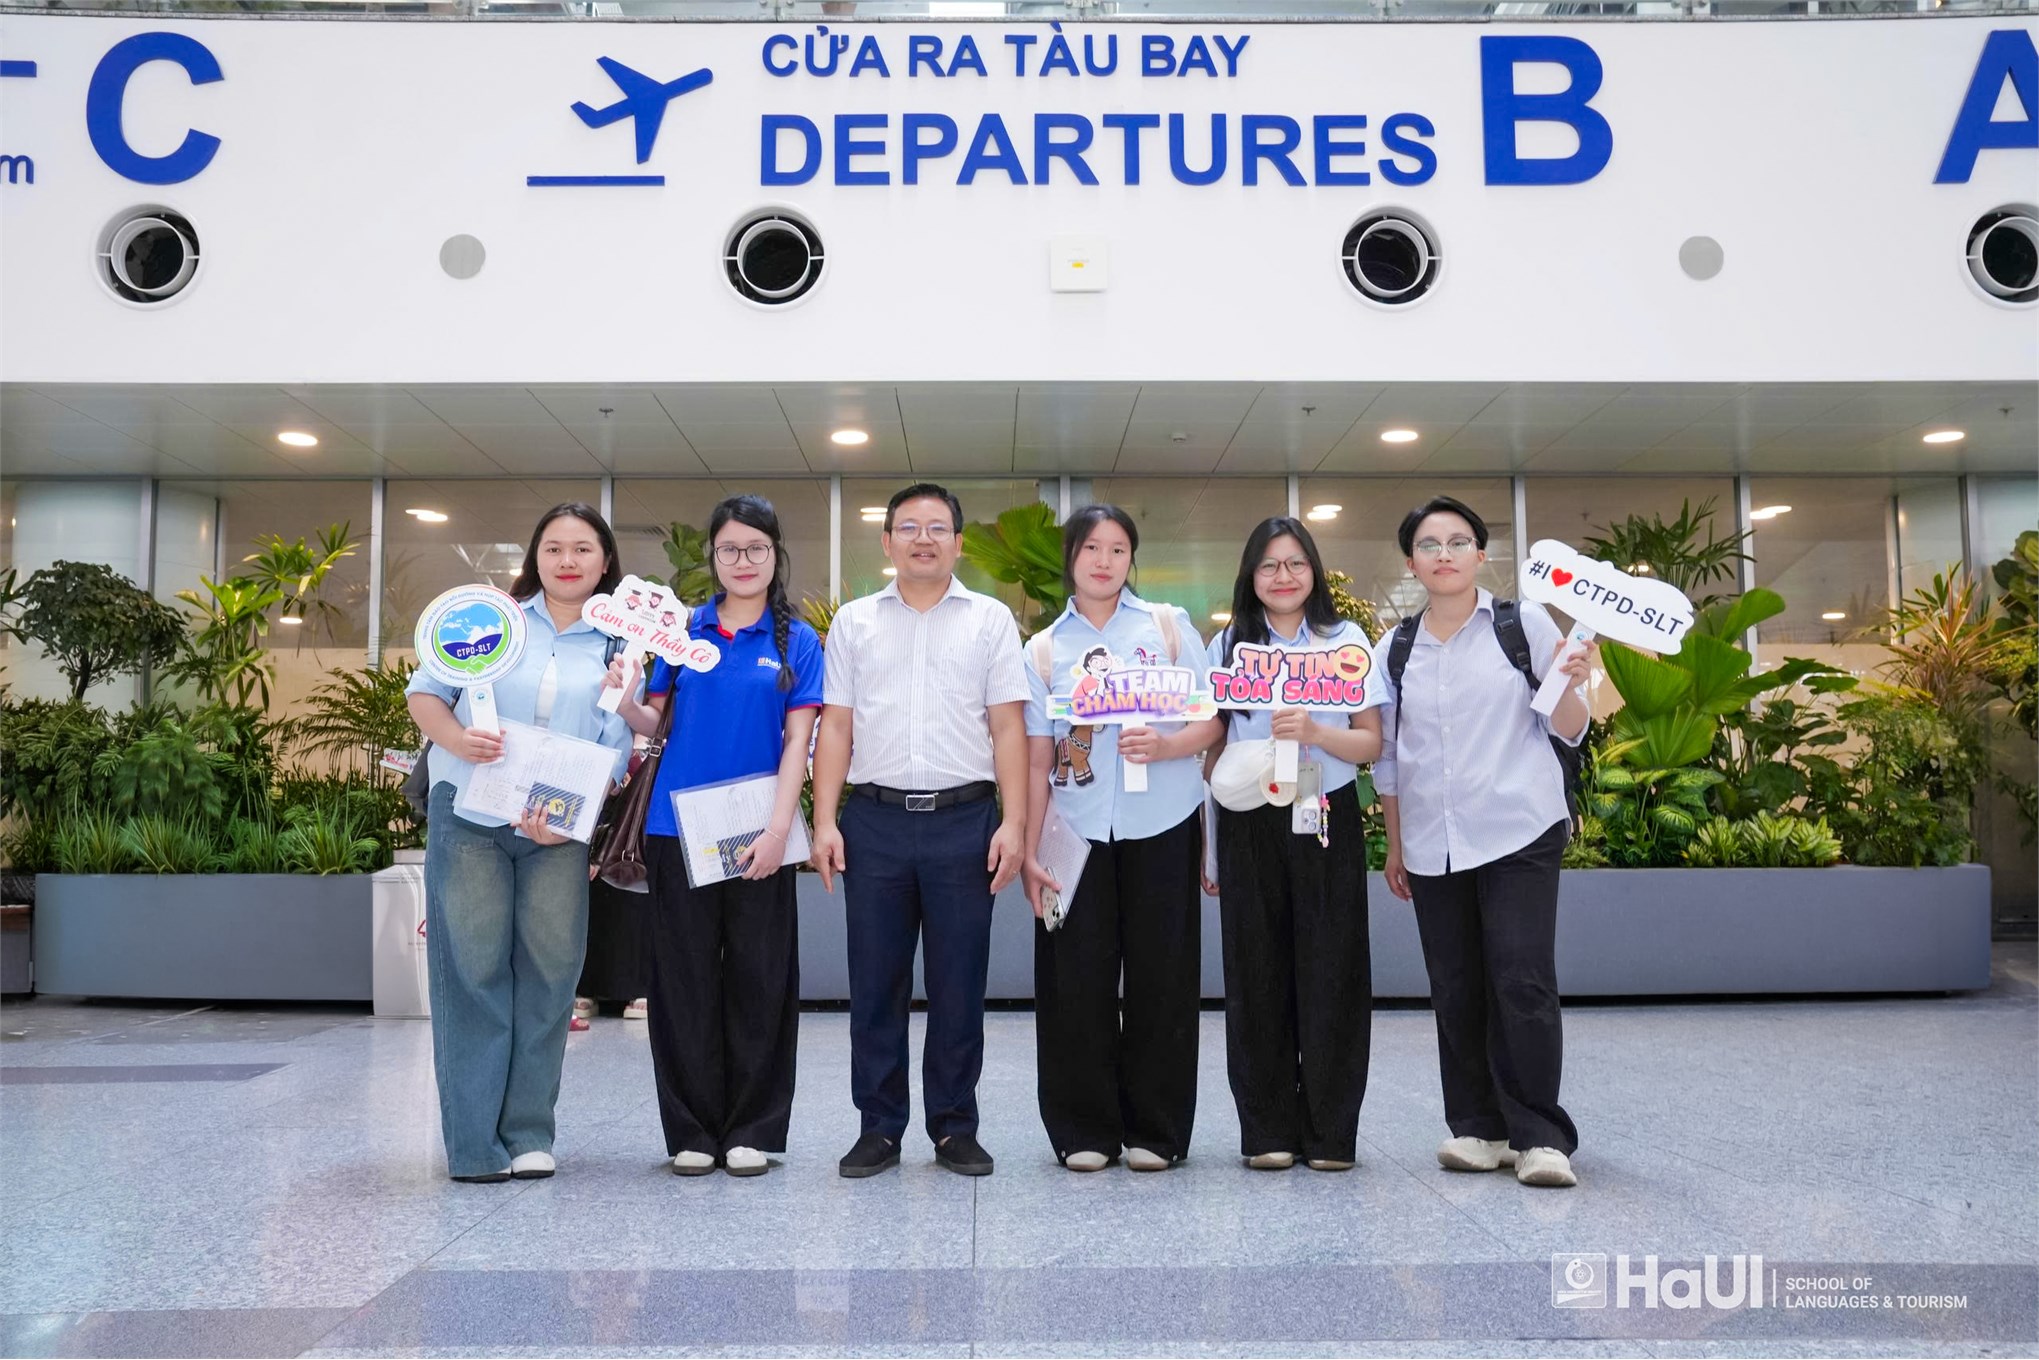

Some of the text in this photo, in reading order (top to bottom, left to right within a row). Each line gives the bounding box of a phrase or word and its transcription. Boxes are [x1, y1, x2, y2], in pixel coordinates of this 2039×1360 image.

[762, 20, 1250, 78] CỬA RA TÀU BAY
[86, 31, 224, 186] C
[1480, 35, 1614, 187] B
[1932, 29, 2039, 185] A
[760, 111, 1439, 188] DEPARTURES
[1572, 578, 1684, 636] CTPD-SLT
[650, 628, 687, 658] Thầy
[690, 646, 712, 663] Cô
[1240, 648, 1337, 684] TỰ TIN
[1072, 688, 1188, 716] CHĂM HỌC
[1110, 670, 1190, 694] TEAM
[1211, 667, 1365, 705] TỎA SÁNG
